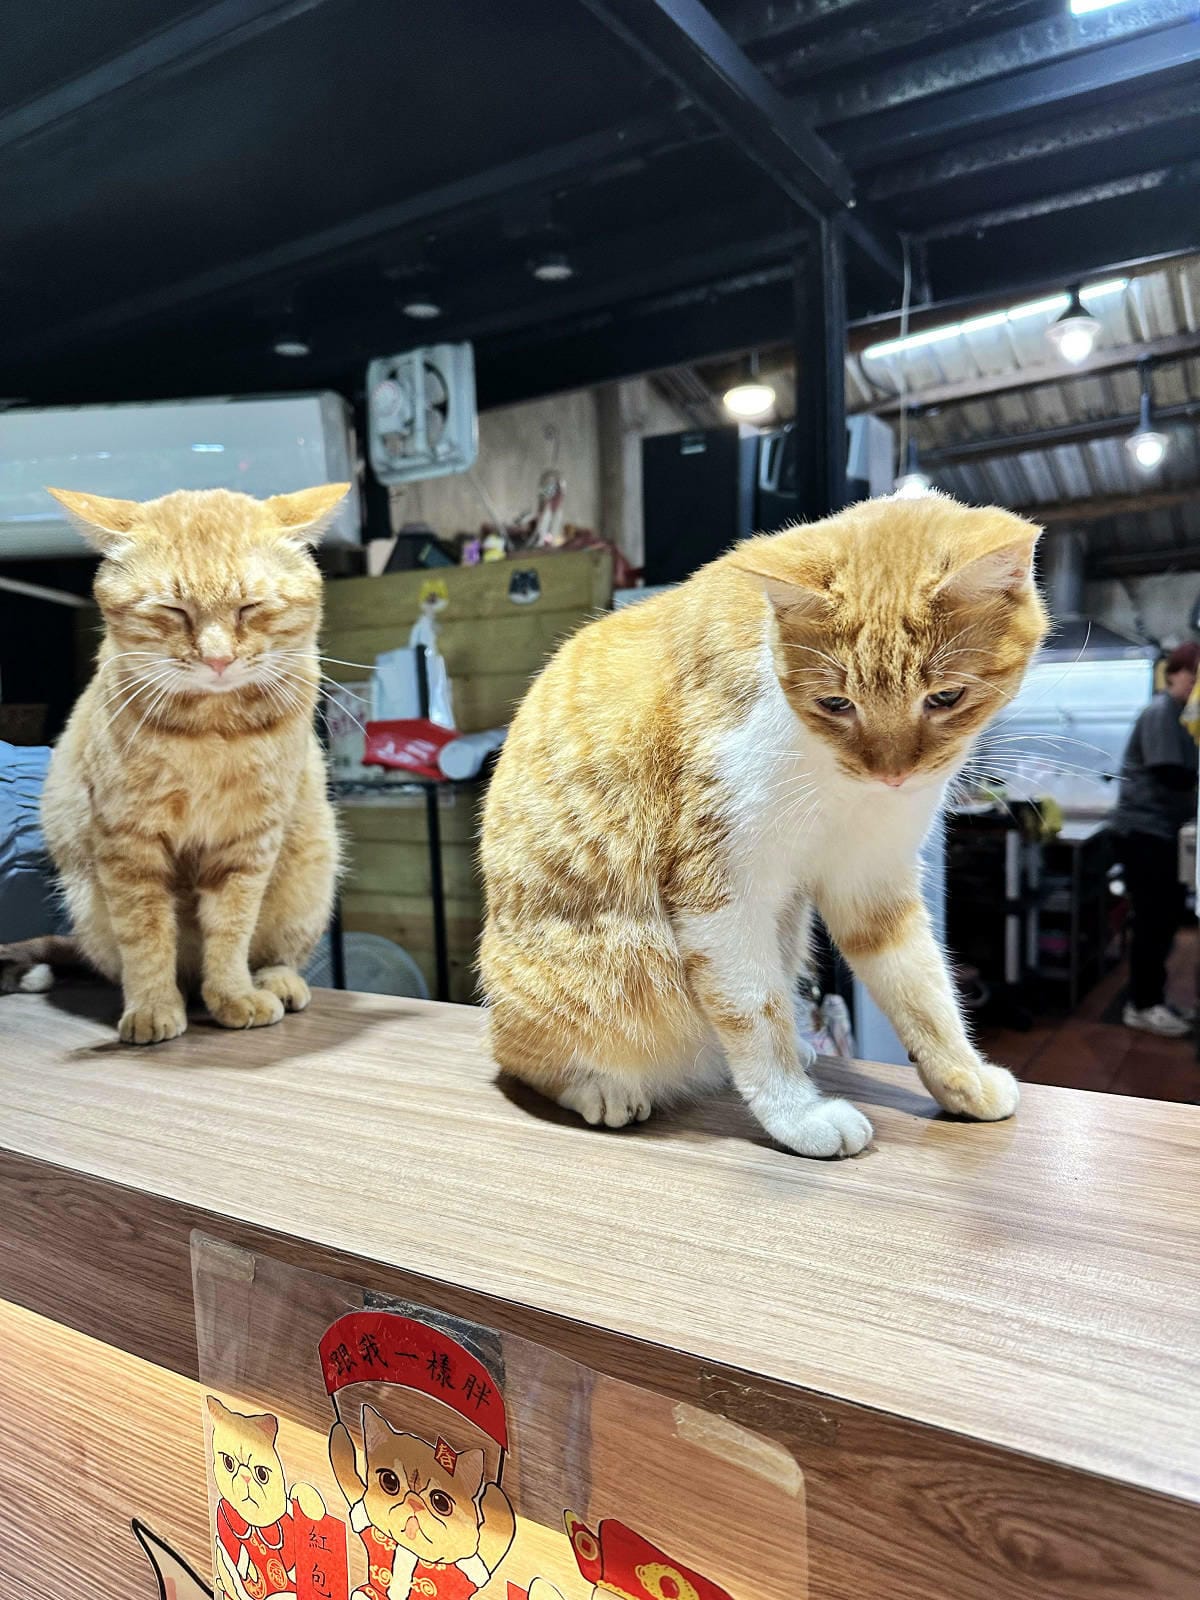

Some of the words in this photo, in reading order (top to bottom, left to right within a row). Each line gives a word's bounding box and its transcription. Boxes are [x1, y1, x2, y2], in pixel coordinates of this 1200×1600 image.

[330, 1333, 492, 1409] 跟我一樣胖
[435, 1443, 456, 1470] 春
[309, 1525, 332, 1599] 紅包
